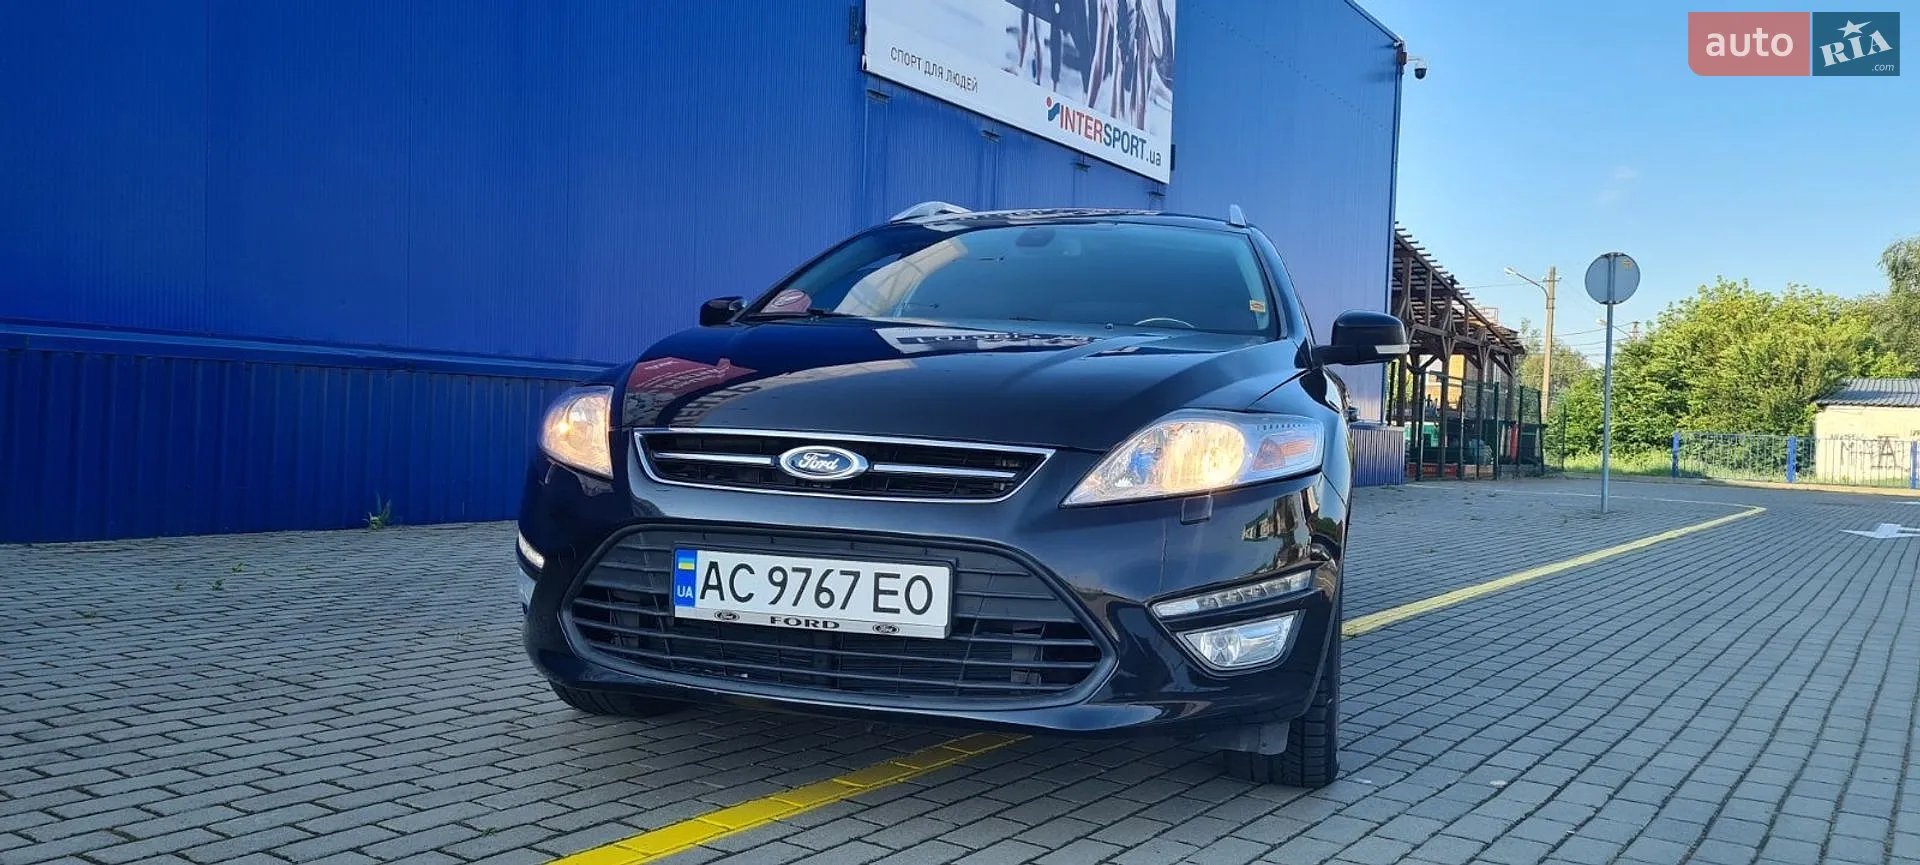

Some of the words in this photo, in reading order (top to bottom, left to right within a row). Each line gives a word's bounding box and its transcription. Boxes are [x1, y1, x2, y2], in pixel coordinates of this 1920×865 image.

[890, 46, 922, 72] СПОРТ
[924, 60, 944, 79] ДЛЯ
[945, 72, 979, 94] ЛЮДЕЙ
[1059, 104, 1162, 167] INTERSPORT.ua
[798, 452, 840, 471] Ford
[676, 584, 694, 599] UA
[699, 561, 756, 604] AC
[767, 566, 861, 610] 9767
[872, 572, 934, 616] EO
[769, 615, 840, 630] FORD
